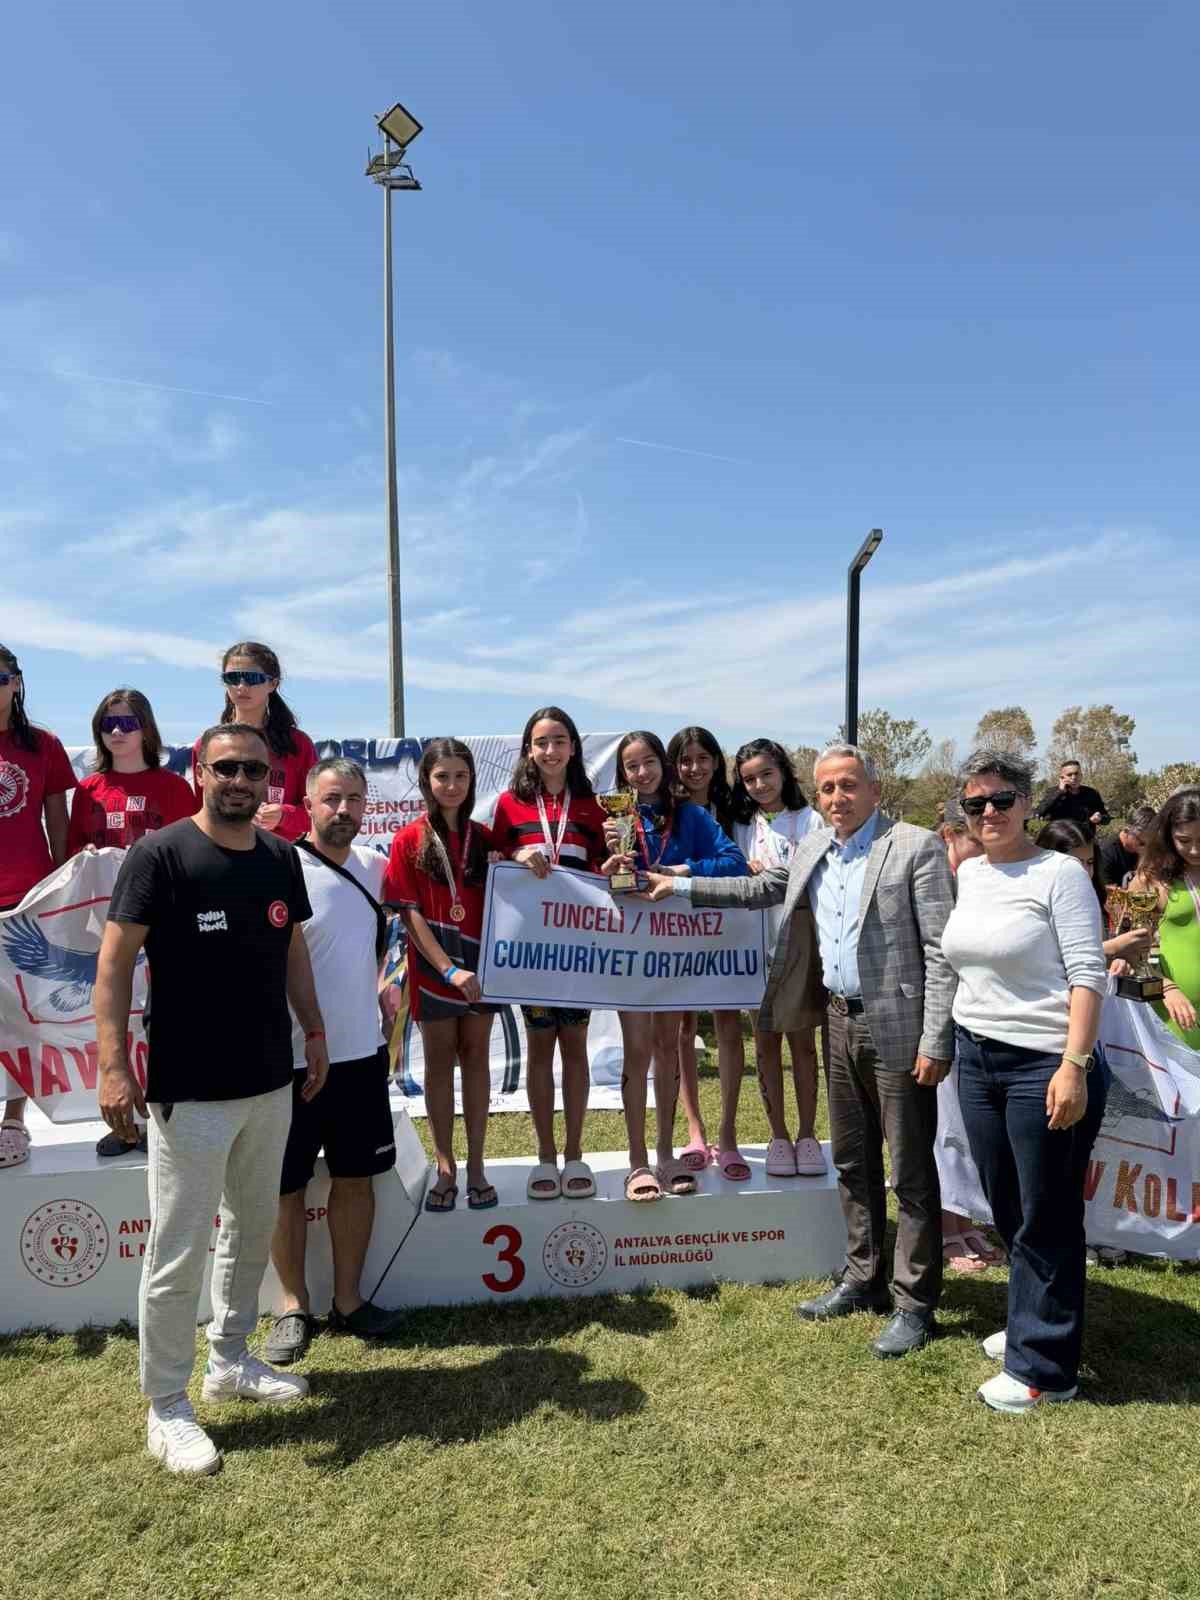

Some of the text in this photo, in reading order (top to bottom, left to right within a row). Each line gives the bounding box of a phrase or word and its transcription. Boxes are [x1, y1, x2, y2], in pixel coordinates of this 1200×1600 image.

[541, 901, 723, 937] TUNCELİ / MERKEZ
[493, 940, 758, 978] CUMHURİYET ORTAOKULU
[119, 1242, 135, 1258] İL
[614, 1230, 785, 1249] ANTALYA GENÇLİK VE SPOR
[482, 1224, 526, 1294] 3
[614, 1248, 713, 1267] İL MÜDÜRLÜĞÜ
